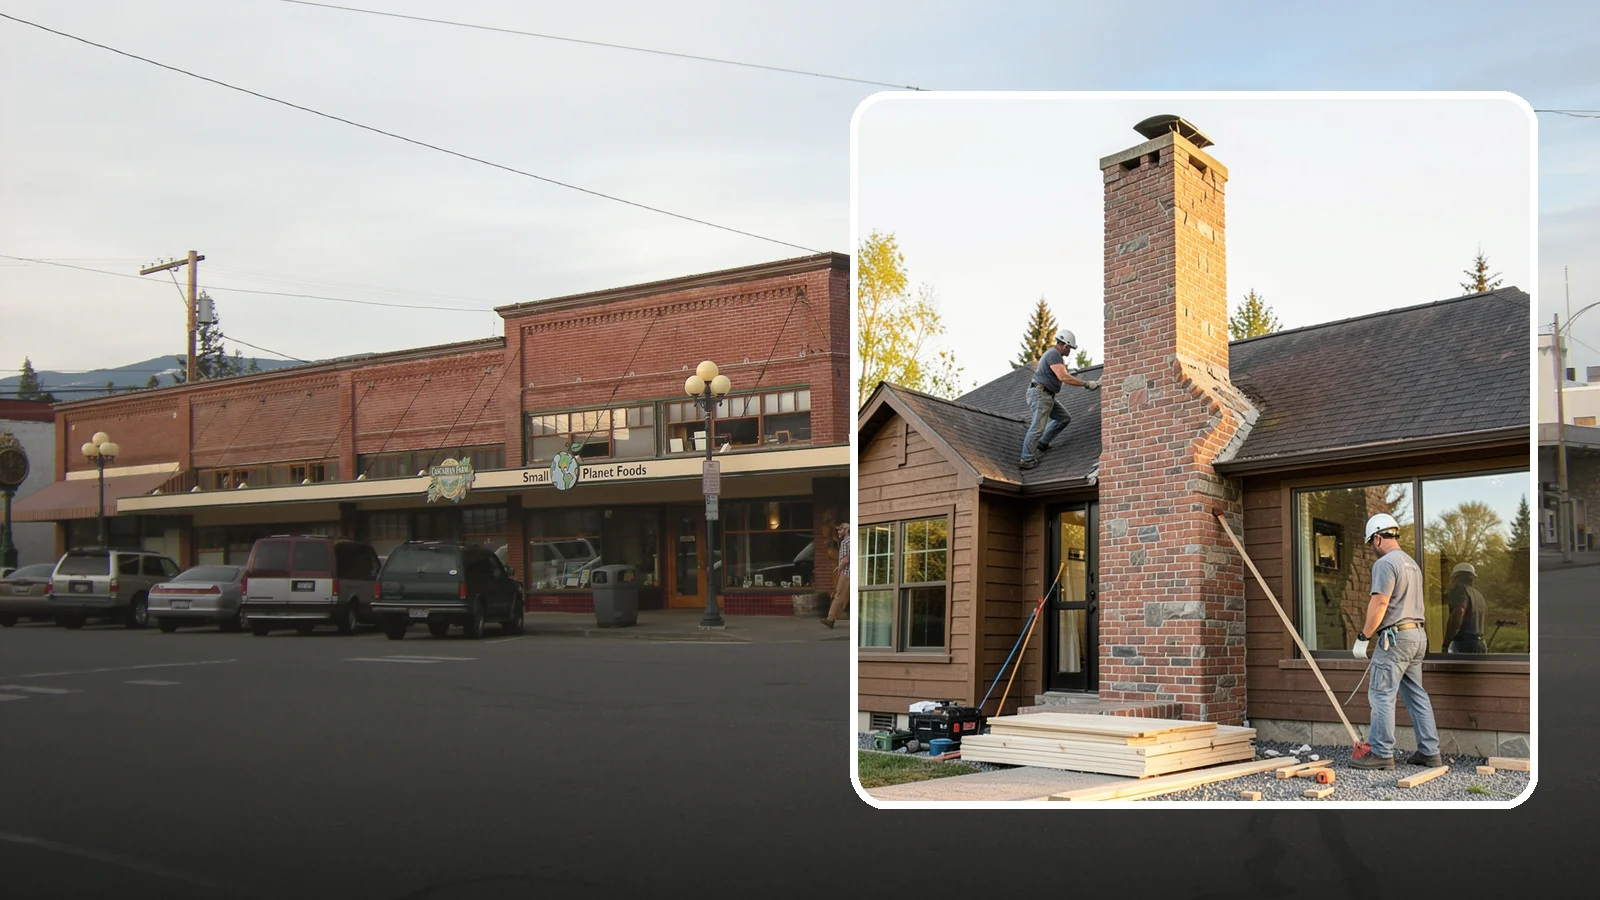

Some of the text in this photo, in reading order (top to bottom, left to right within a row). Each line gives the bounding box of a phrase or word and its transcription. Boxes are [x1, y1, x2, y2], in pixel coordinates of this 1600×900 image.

[523, 464, 647, 483] Small Planet Foods
